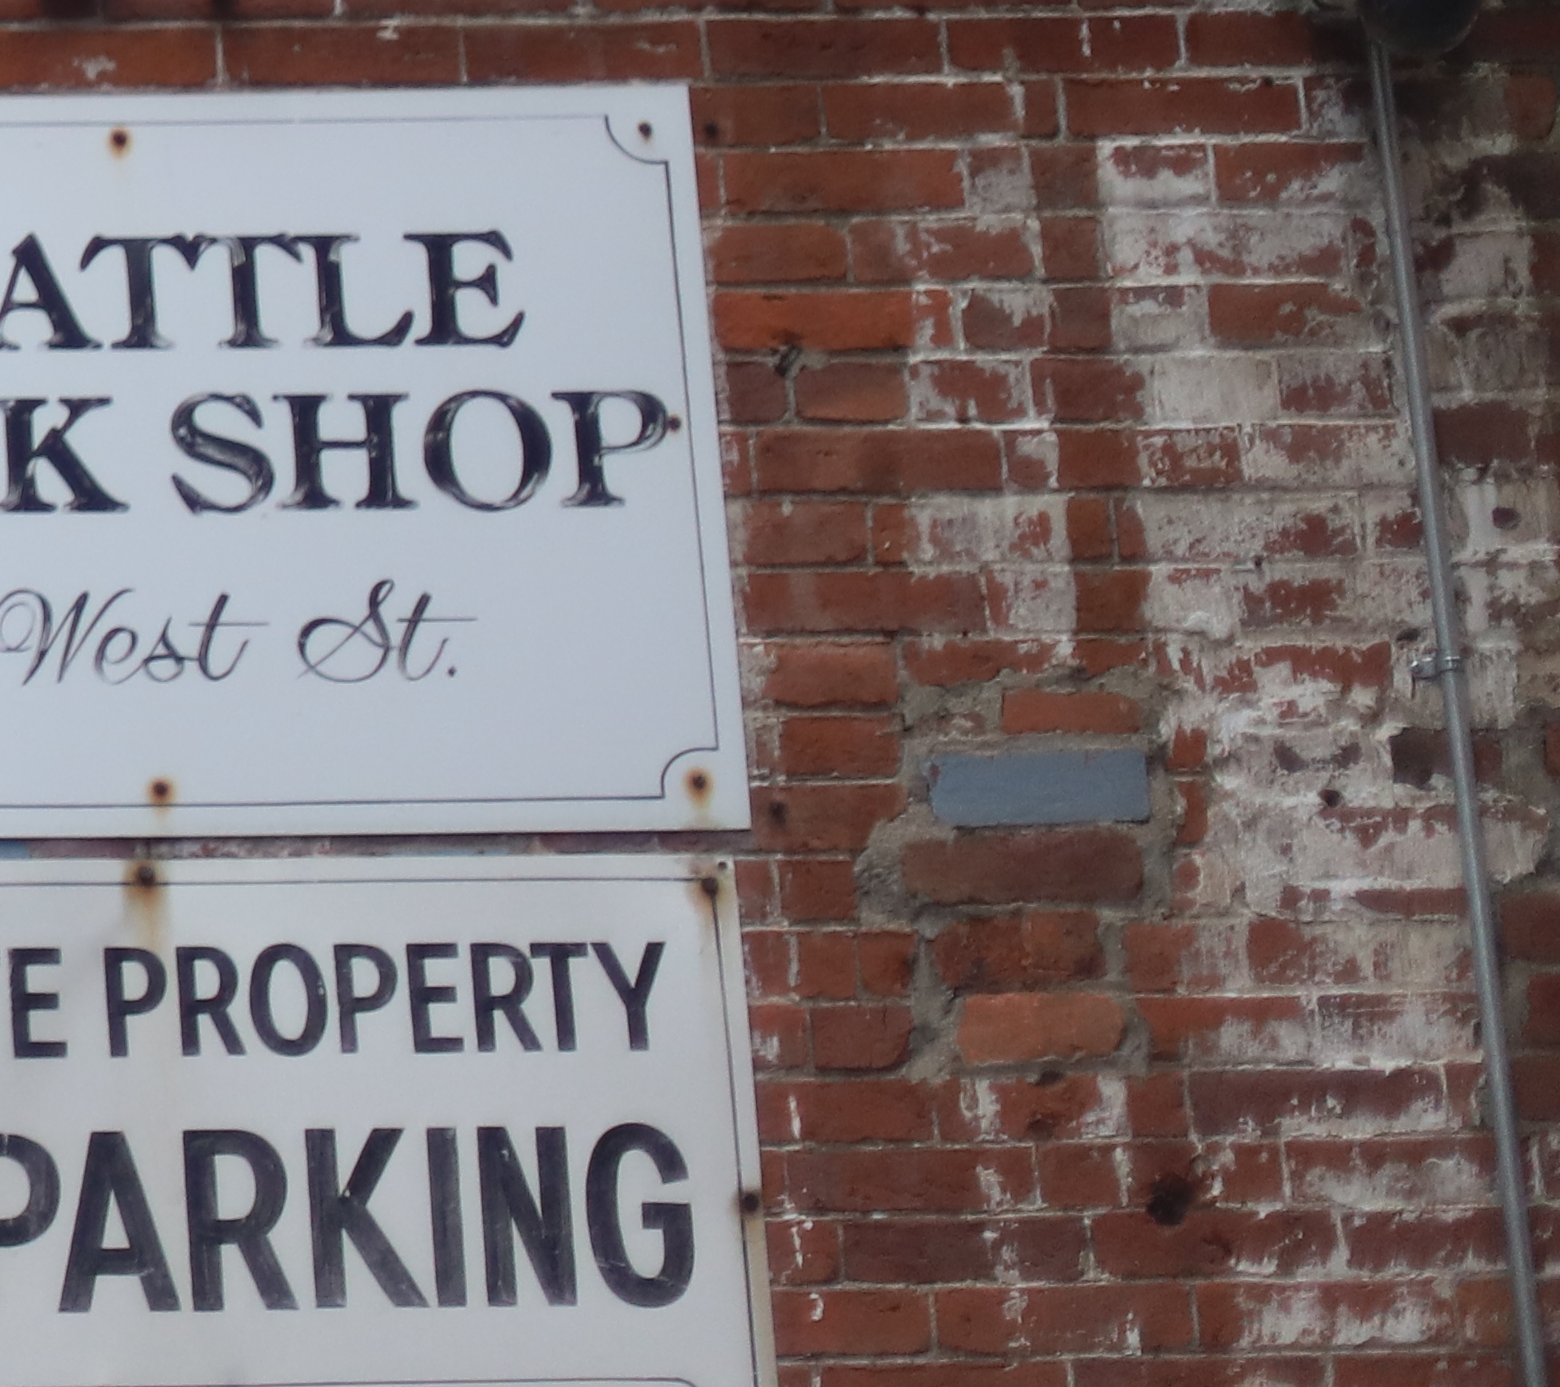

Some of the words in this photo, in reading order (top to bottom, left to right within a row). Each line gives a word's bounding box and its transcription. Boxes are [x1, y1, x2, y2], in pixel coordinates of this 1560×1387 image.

[170, 387, 675, 513] SHOP
[298, 578, 477, 683] St.
[104, 940, 666, 1059] PROPERTY
